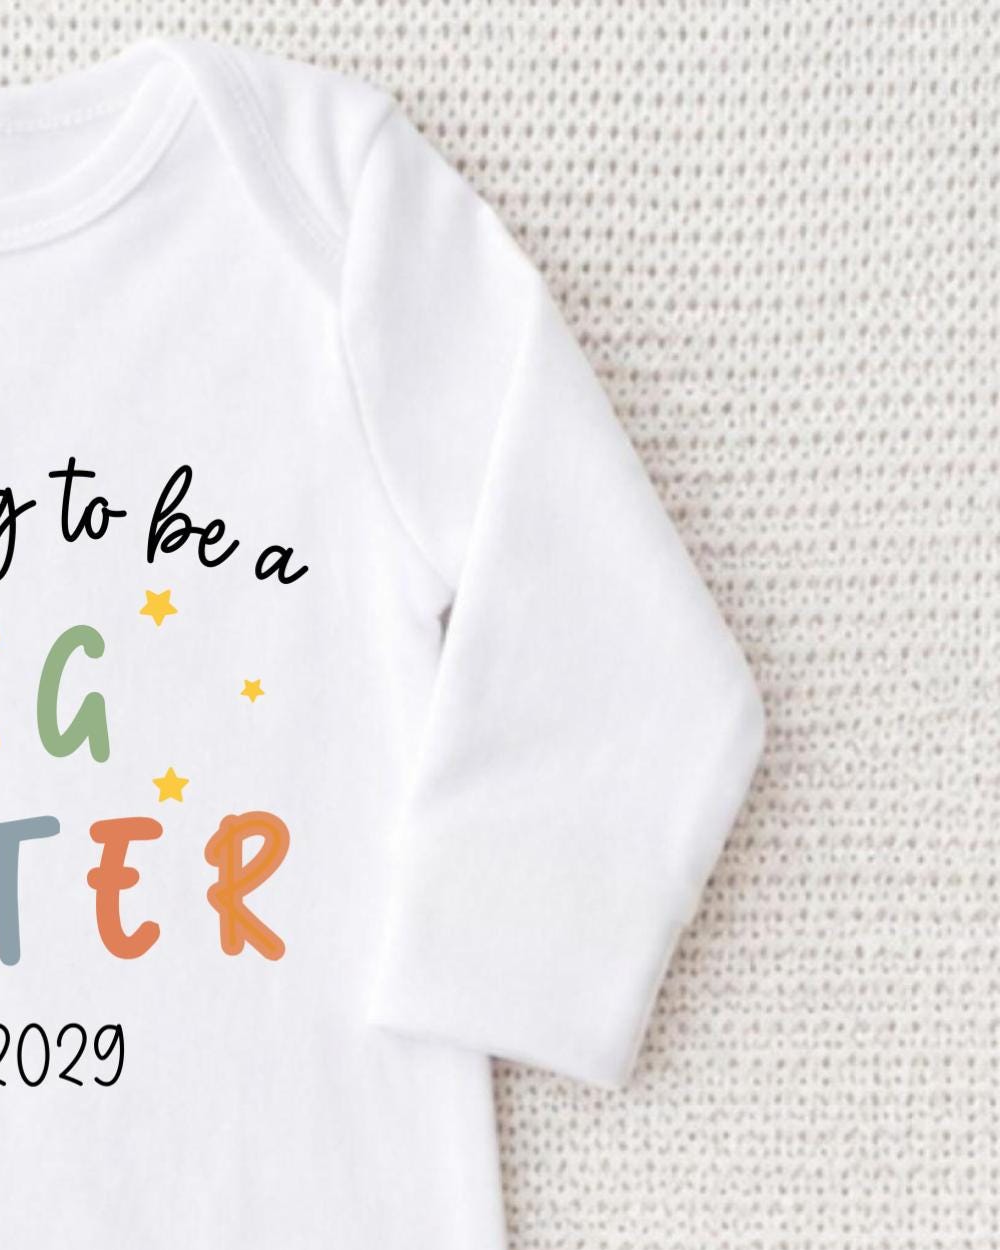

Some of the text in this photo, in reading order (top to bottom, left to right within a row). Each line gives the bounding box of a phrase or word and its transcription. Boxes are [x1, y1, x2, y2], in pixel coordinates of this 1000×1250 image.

[47, 455, 128, 543] to
[146, 464, 241, 569] be
[254, 544, 310, 585] a
